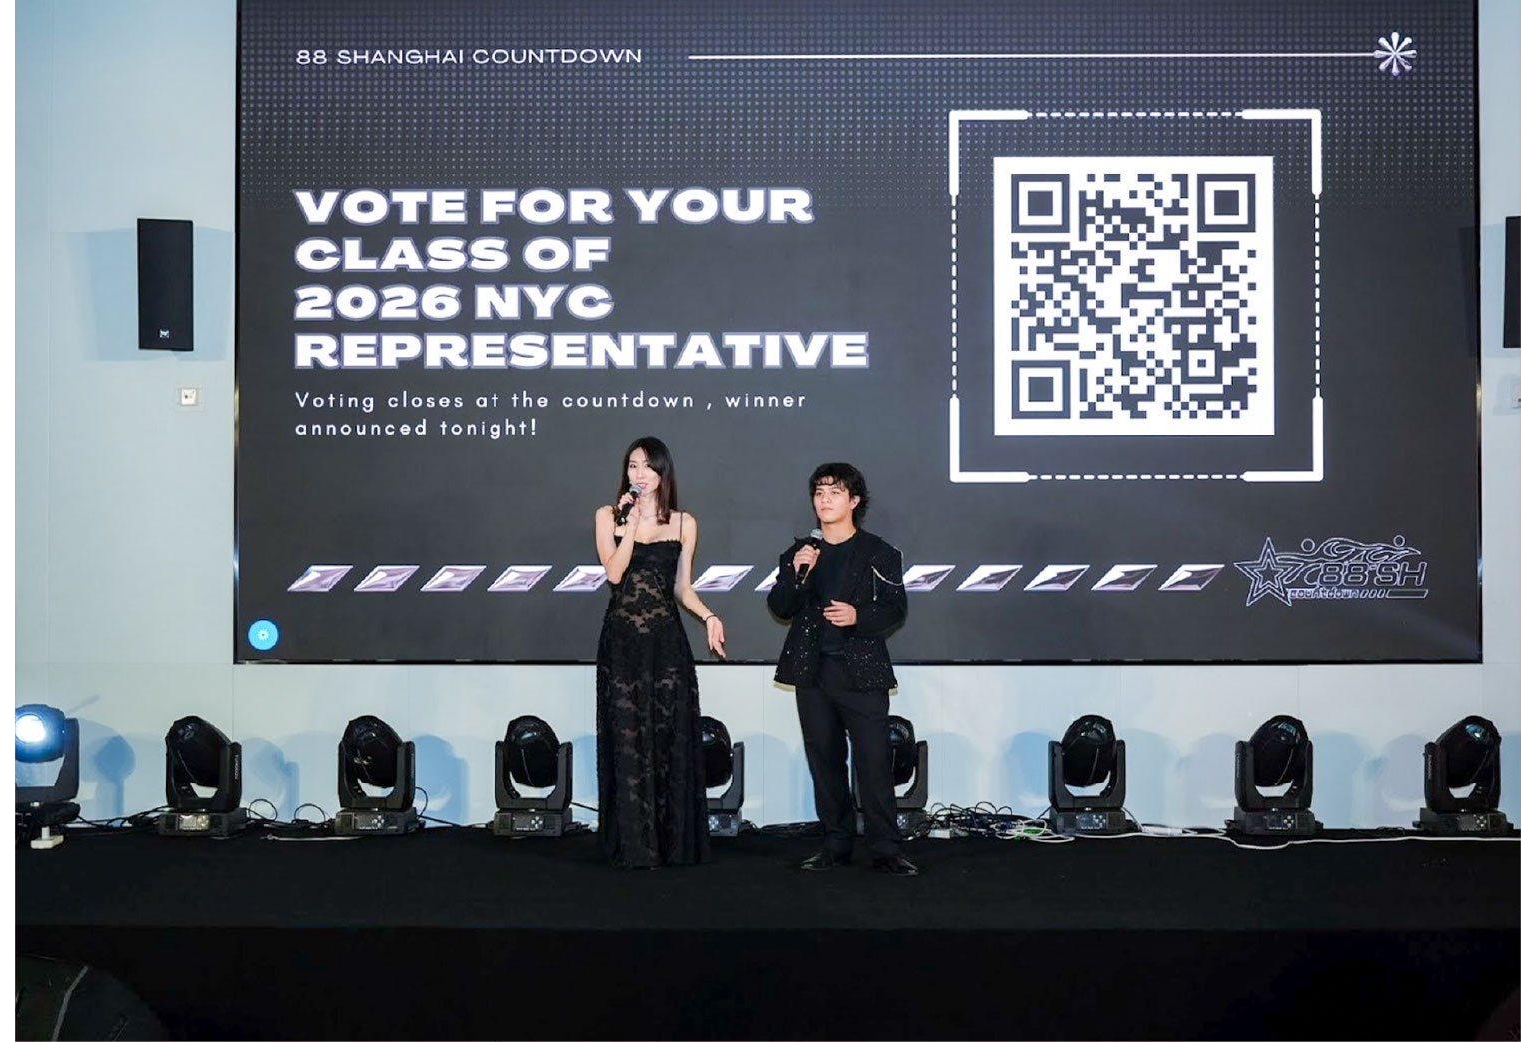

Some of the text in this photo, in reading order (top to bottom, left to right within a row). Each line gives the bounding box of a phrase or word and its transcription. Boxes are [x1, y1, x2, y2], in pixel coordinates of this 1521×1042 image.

[295, 48, 642, 65] 88 SHANGHAI COUNTDOWN
[295, 188, 815, 224] VOTE FOR YOUR
[295, 236, 611, 272] CLASS OF
[295, 284, 614, 320] 2026 NYC
[295, 332, 869, 369] REPRESENTATIVE
[295, 391, 375, 413] Voting
[387, 390, 464, 409] closes
[475, 392, 500, 409] at
[511, 390, 549, 409] the
[562, 390, 694, 409] countdown
[725, 391, 806, 409] winner
[295, 417, 537, 440] announced tonight!
[1290, 587, 1359, 599] countdown
